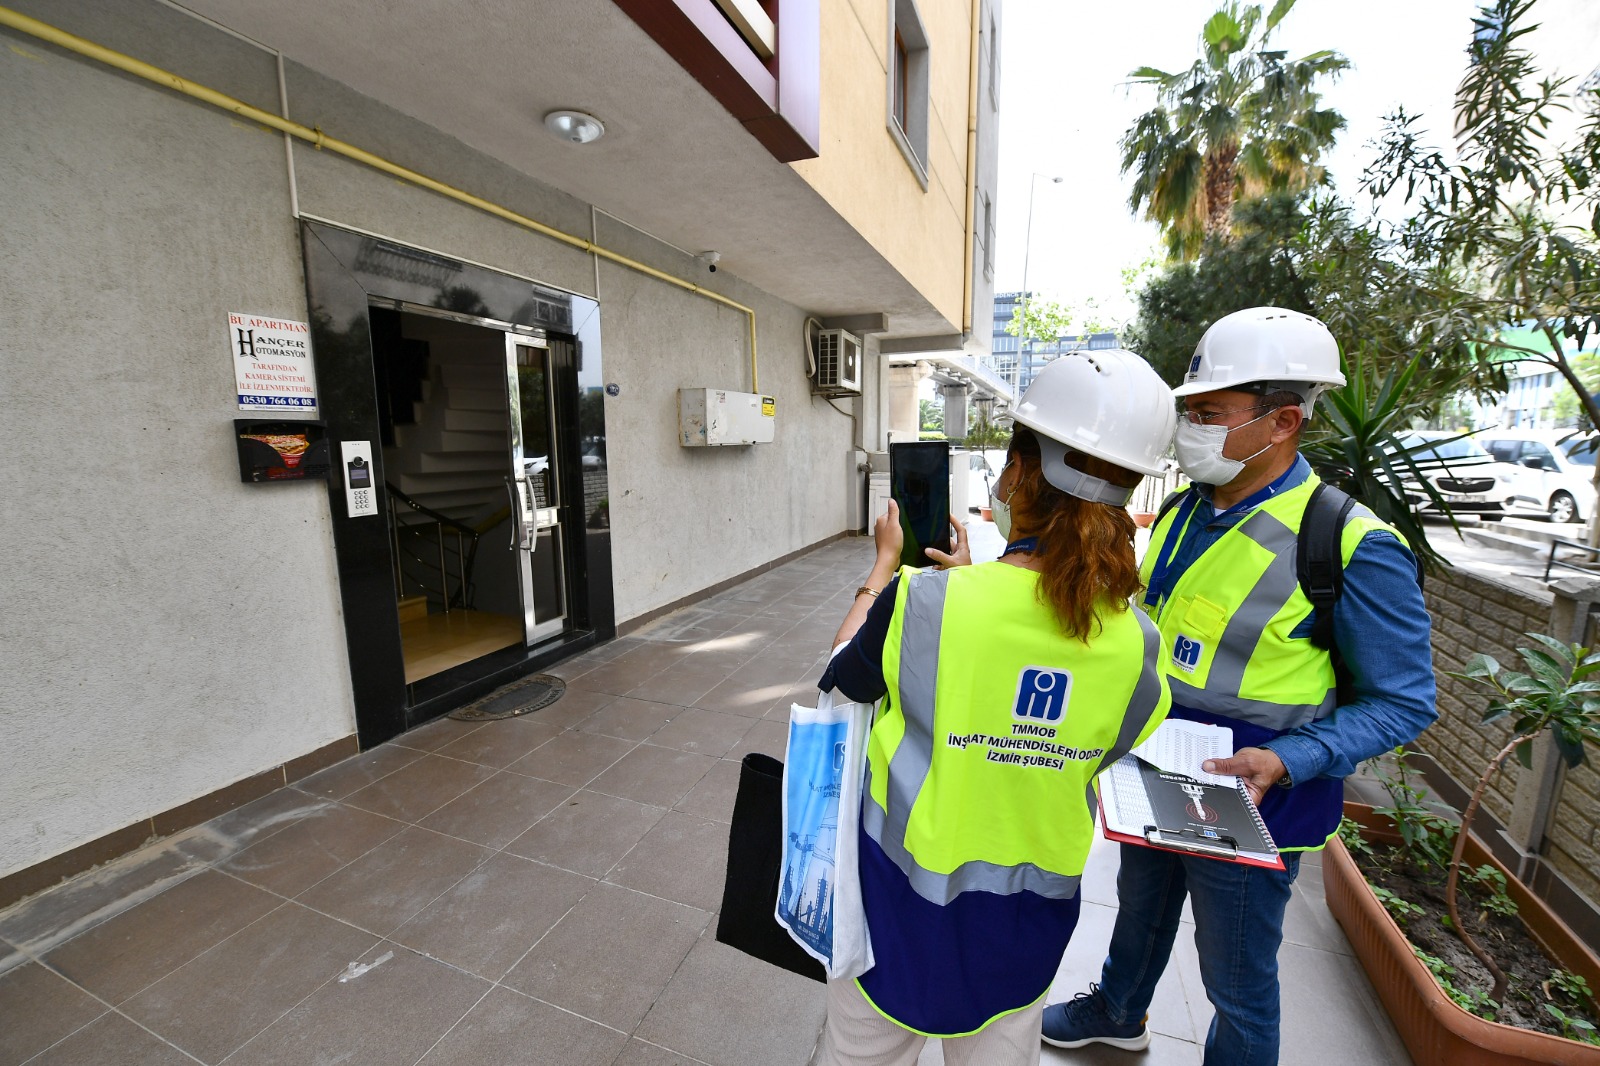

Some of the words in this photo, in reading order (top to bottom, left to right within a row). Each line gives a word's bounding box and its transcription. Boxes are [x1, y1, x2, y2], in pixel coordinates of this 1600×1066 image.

[230, 315, 245, 325] BU
[249, 319, 308, 333] APARTMAN
[256, 347, 306, 358] OTOMASYON
[251, 362, 297, 371] TARAFINDAN
[245, 372, 277, 381] KAMERA
[277, 374, 306, 382] SİSTEMİ
[239, 381, 252, 390] İLE
[242, 396, 267, 405] 0530
[269, 397, 287, 405] 766
[1011, 724, 1056, 738] TMMOB
[987, 736, 1078, 760] MÜHENDİSLERİ
[1078, 748, 1103, 761] ODSI
[986, 749, 1022, 764] İZMİR
[1022, 755, 1065, 770] ŞUBESİ
